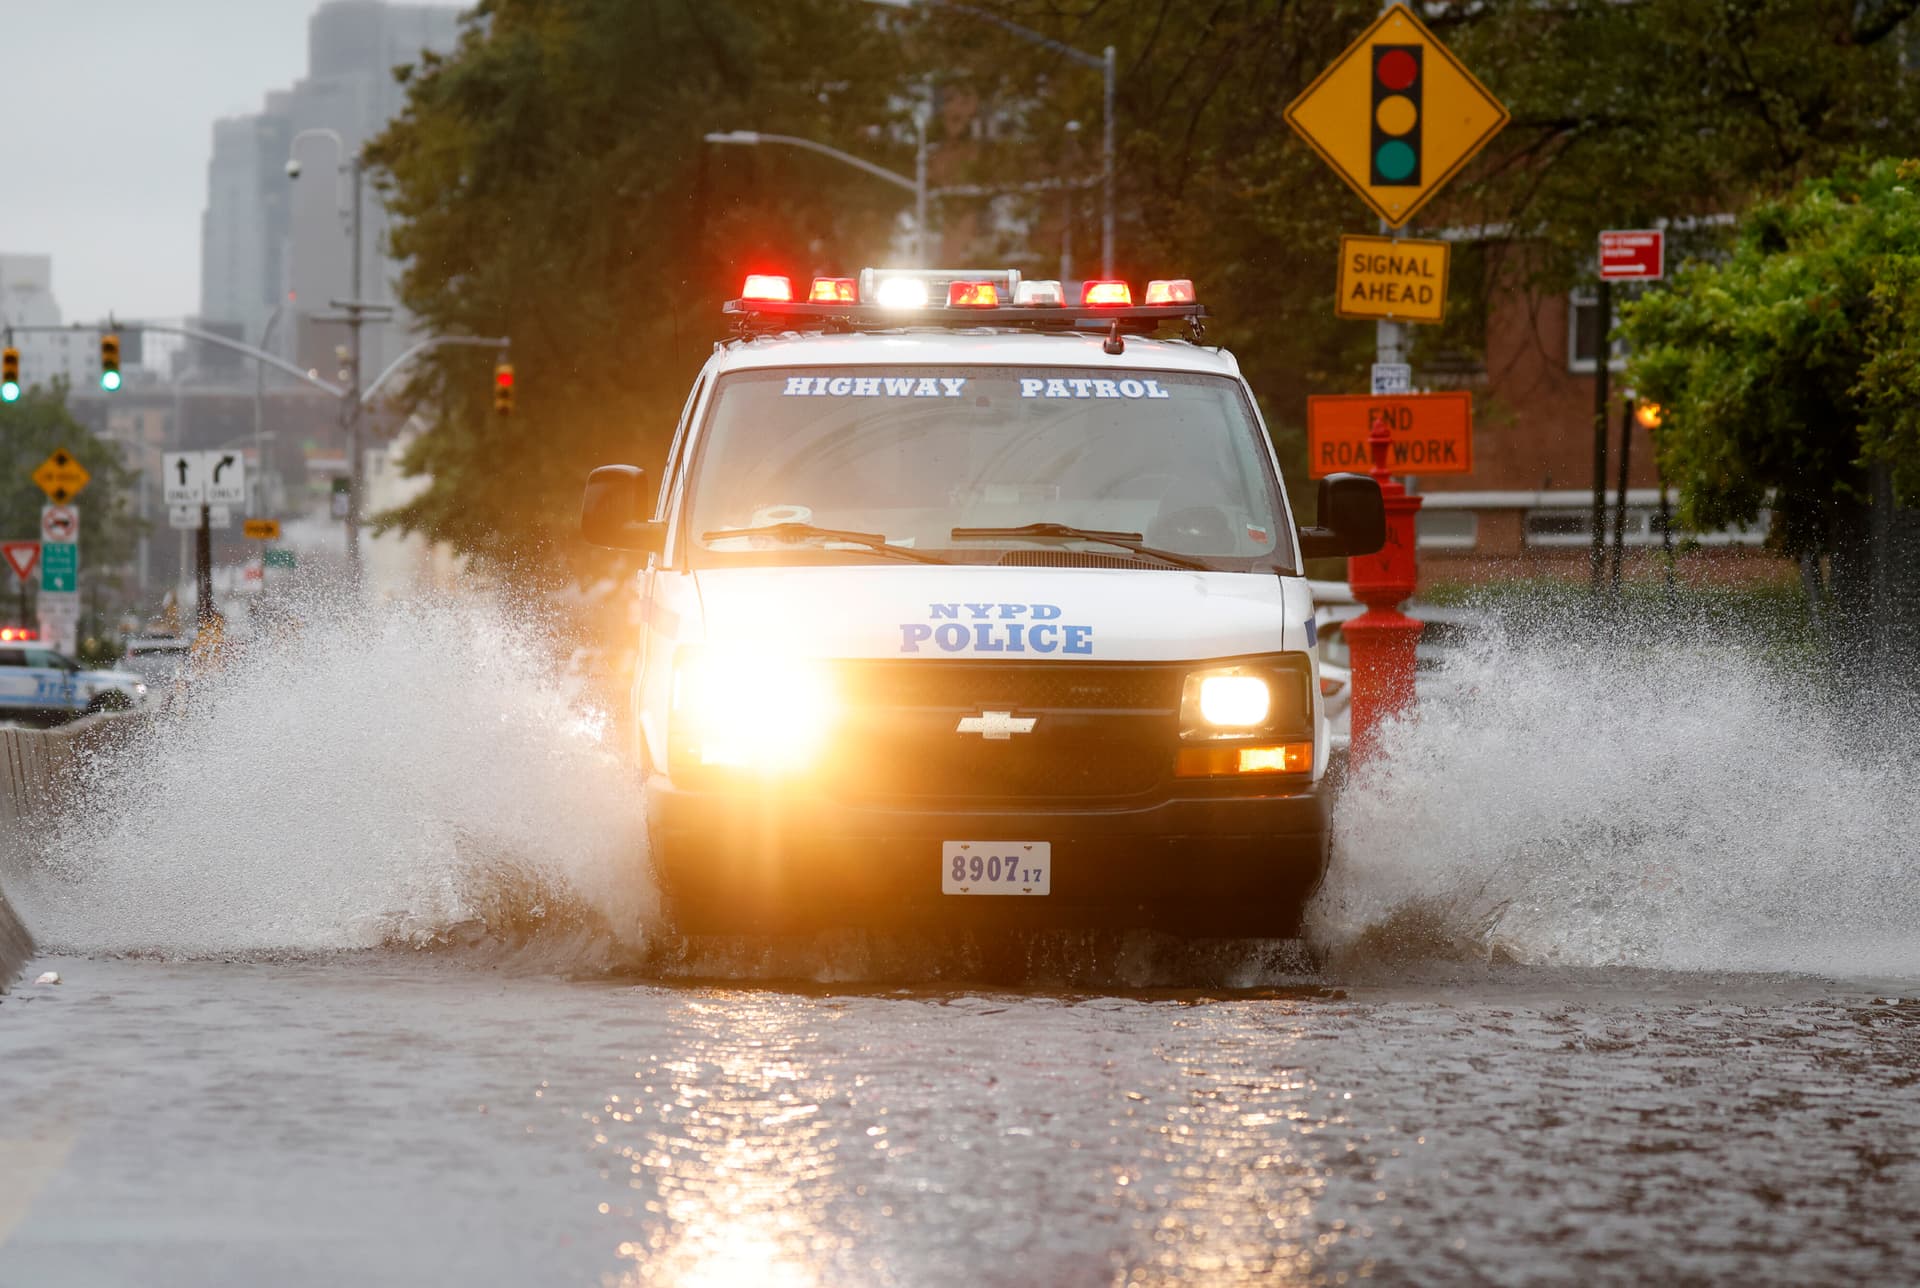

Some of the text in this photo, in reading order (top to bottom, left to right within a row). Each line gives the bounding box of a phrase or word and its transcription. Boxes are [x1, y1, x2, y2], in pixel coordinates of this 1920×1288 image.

[1353, 253, 1435, 278] SIGNAL
[1351, 282, 1434, 305] AHEAD
[782, 376, 1170, 400] HIGHWAY PATROL
[1367, 406, 1413, 431] END
[1391, 440, 1457, 464] WORK
[929, 603, 1062, 620] NYPD
[899, 623, 1093, 655] POLICE
[951, 855, 1042, 882] 8907 17
